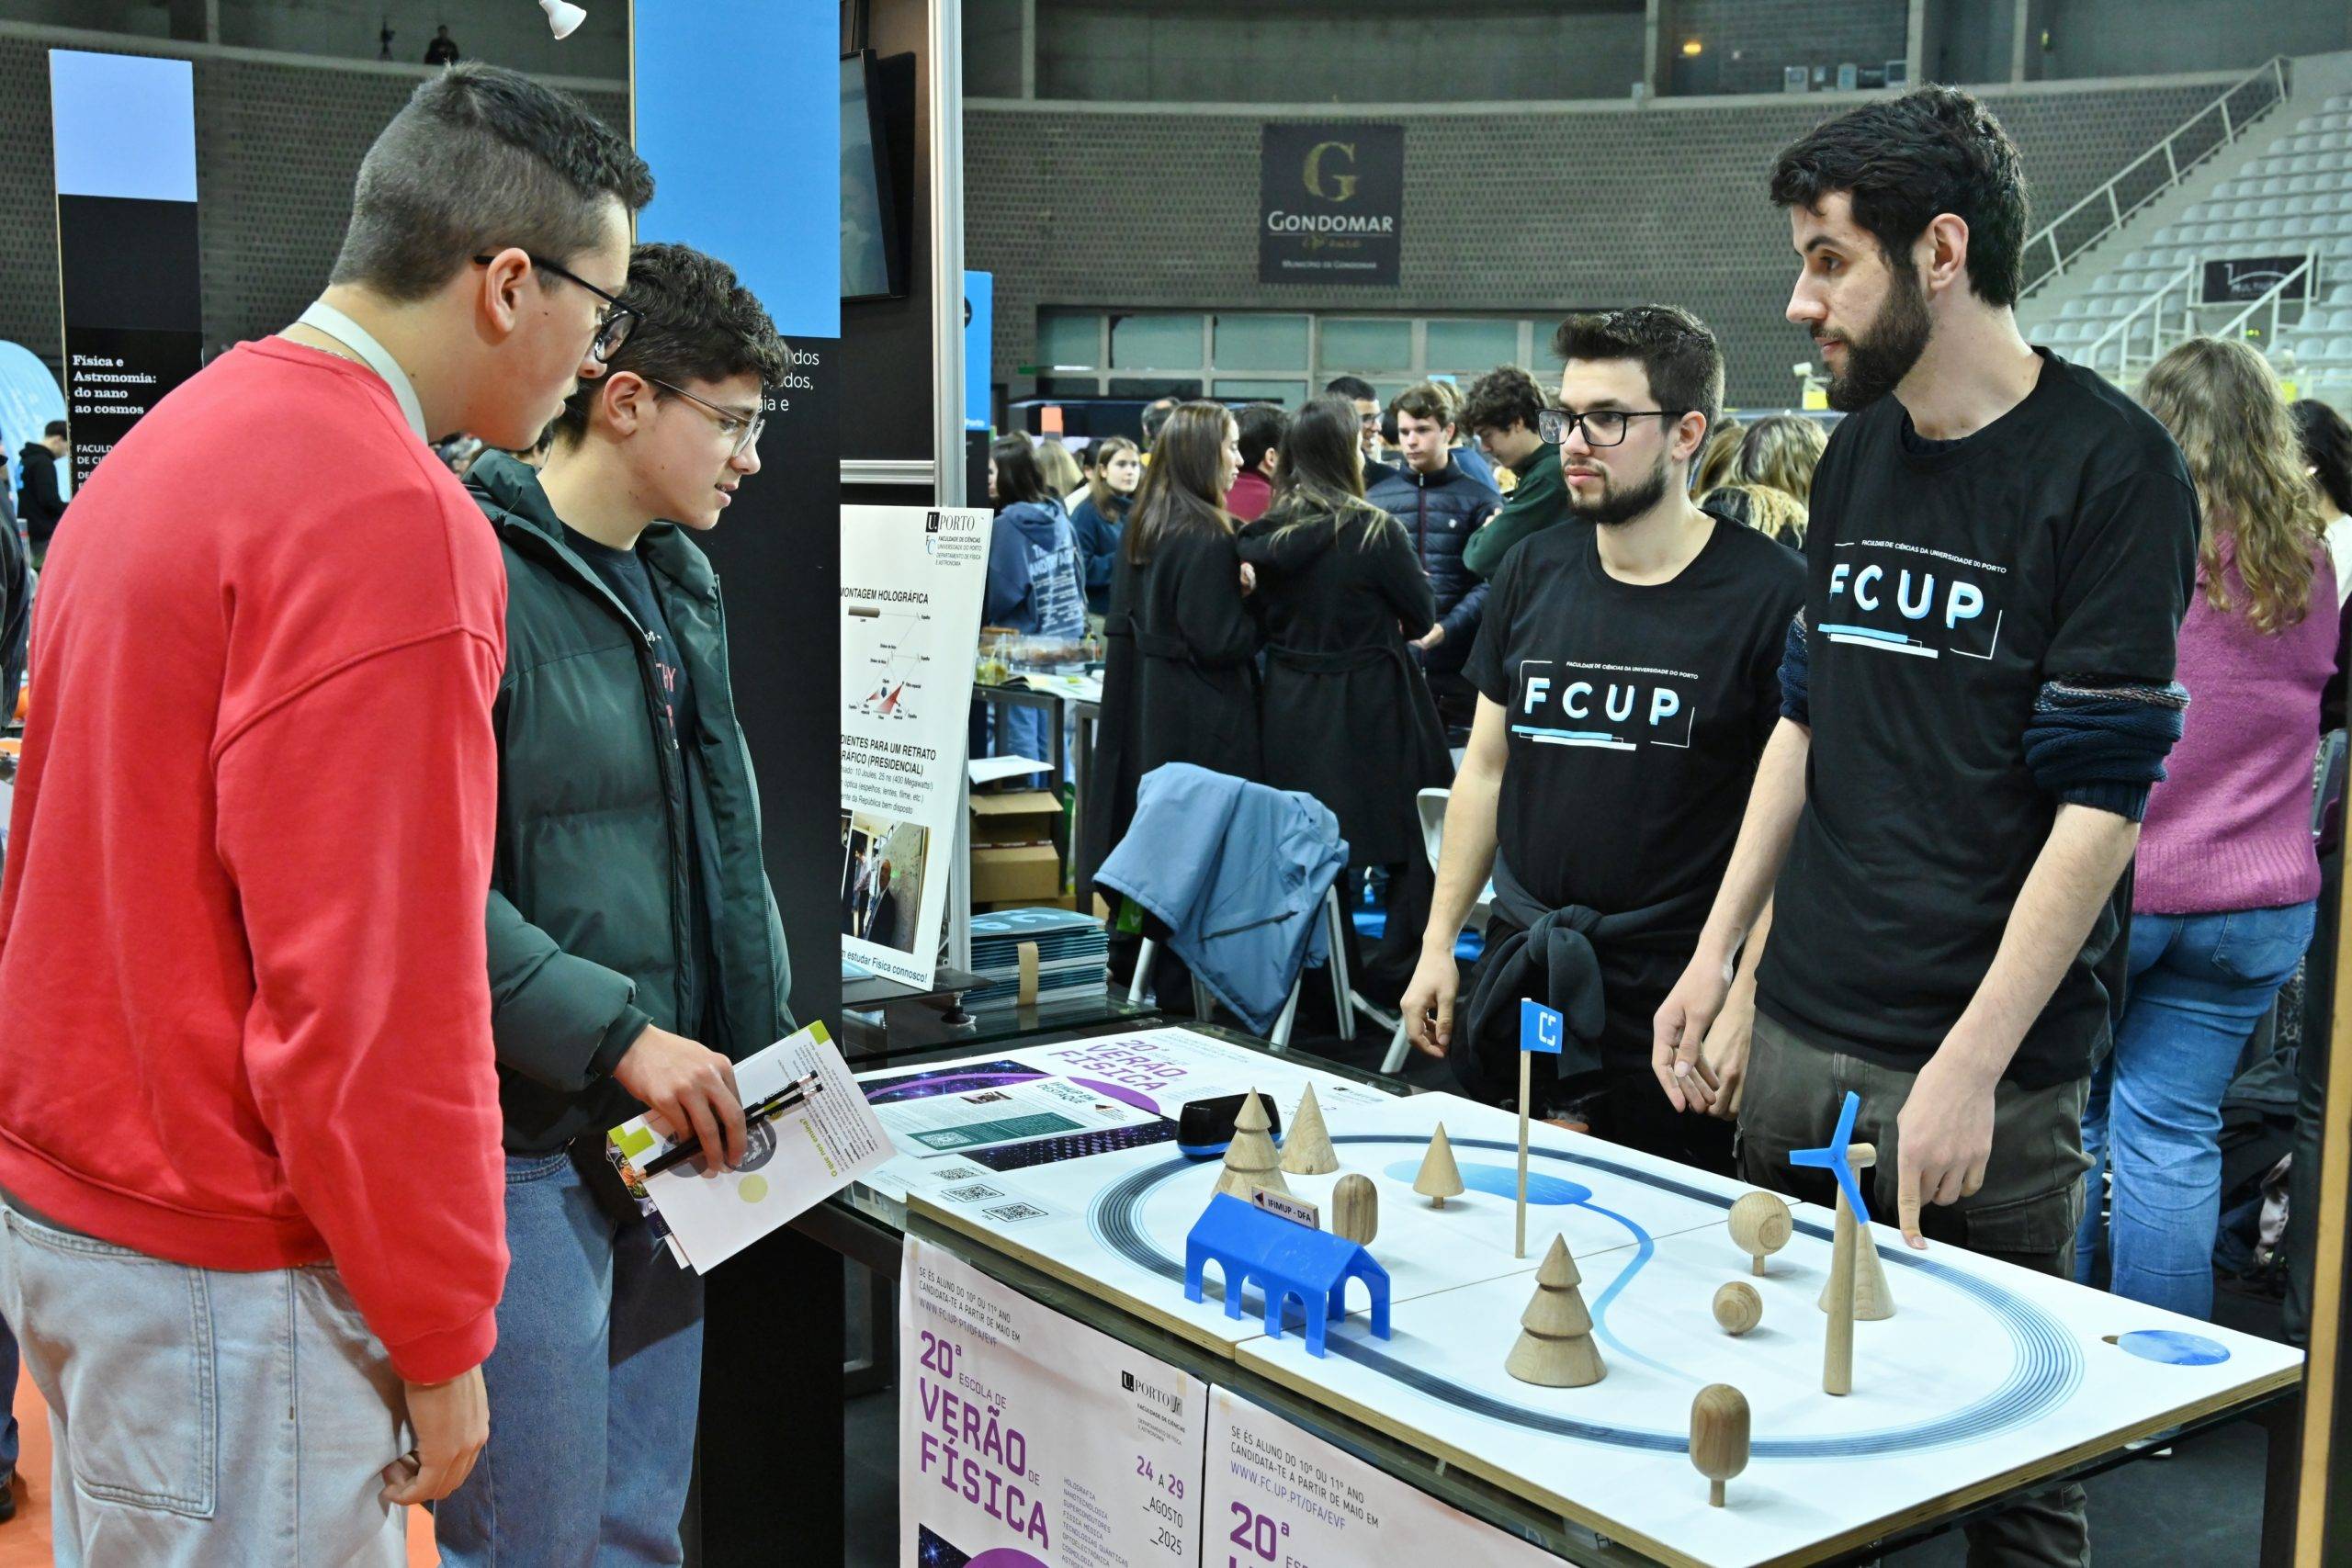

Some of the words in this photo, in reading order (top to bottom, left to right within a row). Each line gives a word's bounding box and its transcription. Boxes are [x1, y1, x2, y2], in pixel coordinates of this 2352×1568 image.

[1303, 141, 1360, 202] G
[1268, 211, 1393, 231] GONDOMAR
[73, 355, 113, 367] Física
[116, 358, 123, 367] e
[74, 371, 156, 384] Astronomia:
[74, 387, 92, 398] do
[94, 389, 128, 399] nano
[783, 372, 814, 389] dos,
[75, 404, 91, 413] ao
[94, 405, 143, 414] cosmos
[781, 399, 788, 412] e
[77, 457, 90, 465] DE
[1895, 543, 1919, 552] CIÊNCIAS
[1930, 549, 1972, 565] UNIVERSIDADE
[1982, 563, 2007, 573] PORTO
[878, 590, 928, 604] HOLOGRÁFICA
[1830, 564, 1984, 628] FCUP
[1524, 677, 1679, 726] FCUP
[841, 735, 868, 749] DIENTES
[870, 739, 888, 752] PARA
[890, 743, 900, 753] UM
[902, 745, 936, 761] RETRATO
[842, 750, 866, 764] RÁFICO
[868, 756, 923, 777] (PRESIDENCIAL)
[847, 951, 871, 965] estudar
[893, 965, 927, 983] connosco!
[1086, 1044, 1188, 1078] VERÃO
[799, 1118, 819, 1143] ensina?
[824, 1156, 835, 1170] que
[1268, 1199, 1292, 1214] IFIMUP
[1297, 1210, 1311, 1222] DFA
[920, 1268, 926, 1278] SE
[928, 1269, 934, 1282] ÉS
[937, 1276, 955, 1292] ALUNO
[956, 1286, 964, 1297] DO
[978, 1297, 985, 1309] OU
[999, 1310, 1011, 1323] ANO
[920, 1280, 956, 1308] CANDIDATA-TE
[959, 1303, 963, 1311] A
[965, 1304, 984, 1324] PARTIR
[987, 1317, 993, 1327] DE
[996, 1323, 1010, 1337] MAIO
[1012, 1331, 1020, 1343] EM
[921, 1330, 961, 1379] 20ª
[959, 1372, 992, 1402] ESCOLA
[995, 1393, 1007, 1410] DE
[921, 1377, 1025, 1477] VERÃO
[1029, 1470, 1040, 1486] DE
[1137, 1455, 1153, 1481] 24
[1159, 1473, 1164, 1489] A
[1169, 1474, 1183, 1500] 29
[1232, 1426, 1240, 1439] SE
[1244, 1429, 1253, 1445] ÉS
[1257, 1438, 1283, 1460] ALUNO
[1286, 1453, 1296, 1467] DO
[1300, 1461, 1312, 1473] 10º
[1317, 1469, 1327, 1483] OU
[1330, 1477, 1343, 1490] 11º
[1347, 1486, 1364, 1504] ANO
[922, 1431, 1049, 1551] FÍSICA
[1064, 1477, 1095, 1502] HOLOGRAFIA
[1230, 1461, 1345, 1530] WWW.FC.UP.PT/DFA/EVF
[1231, 1442, 1286, 1479] CANDIDATA-TE
[1289, 1472, 1295, 1483] A
[1298, 1476, 1327, 1499] PARTIR
[1330, 1493, 1340, 1507] DE
[1343, 1500, 1363, 1519] MAIO
[1367, 1513, 1379, 1529] EM
[1063, 1499, 1111, 1534] SUPERCONDUTORES
[1064, 1488, 1108, 1519] NANOTECNOLOGIA
[1230, 1501, 1290, 1562] 20ª
